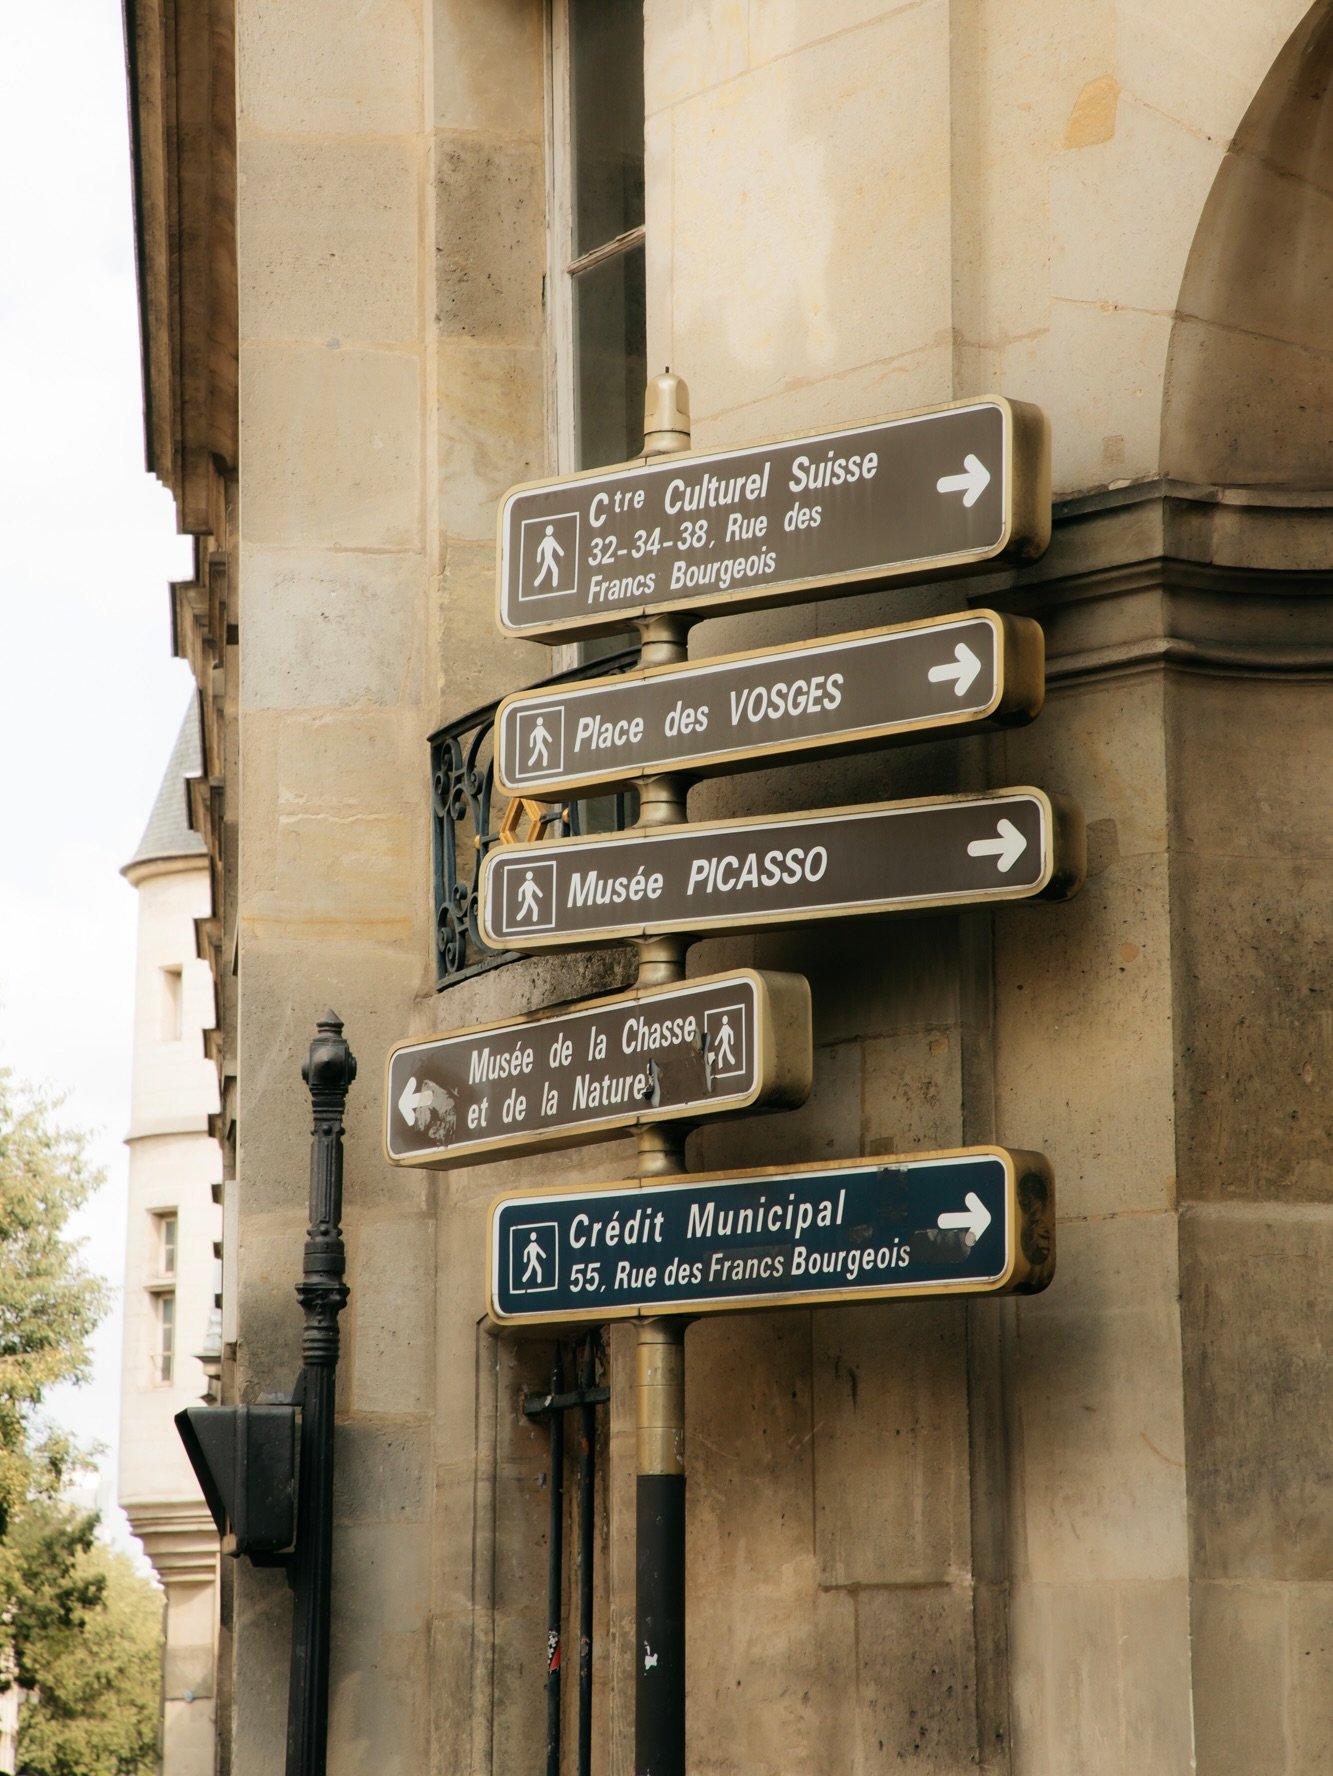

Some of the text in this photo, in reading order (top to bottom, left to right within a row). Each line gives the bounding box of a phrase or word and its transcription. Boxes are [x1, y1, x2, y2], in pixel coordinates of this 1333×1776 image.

[590, 451, 877, 527] Ctre Culturel Suisse
[587, 502, 821, 567] 32-34-38, Rue des
[588, 546, 776, 603] Francs Bourgeois
[574, 674, 843, 752] Place des VOSGES
[567, 846, 827, 907] Musée PICASSO
[469, 1016, 696, 1084] Musée de la Chasse
[468, 1074, 646, 1129] et de la Nature
[570, 1189, 845, 1248] Crédit Municipal
[570, 1238, 910, 1292] 55, Rue des Francs Bourgeois
